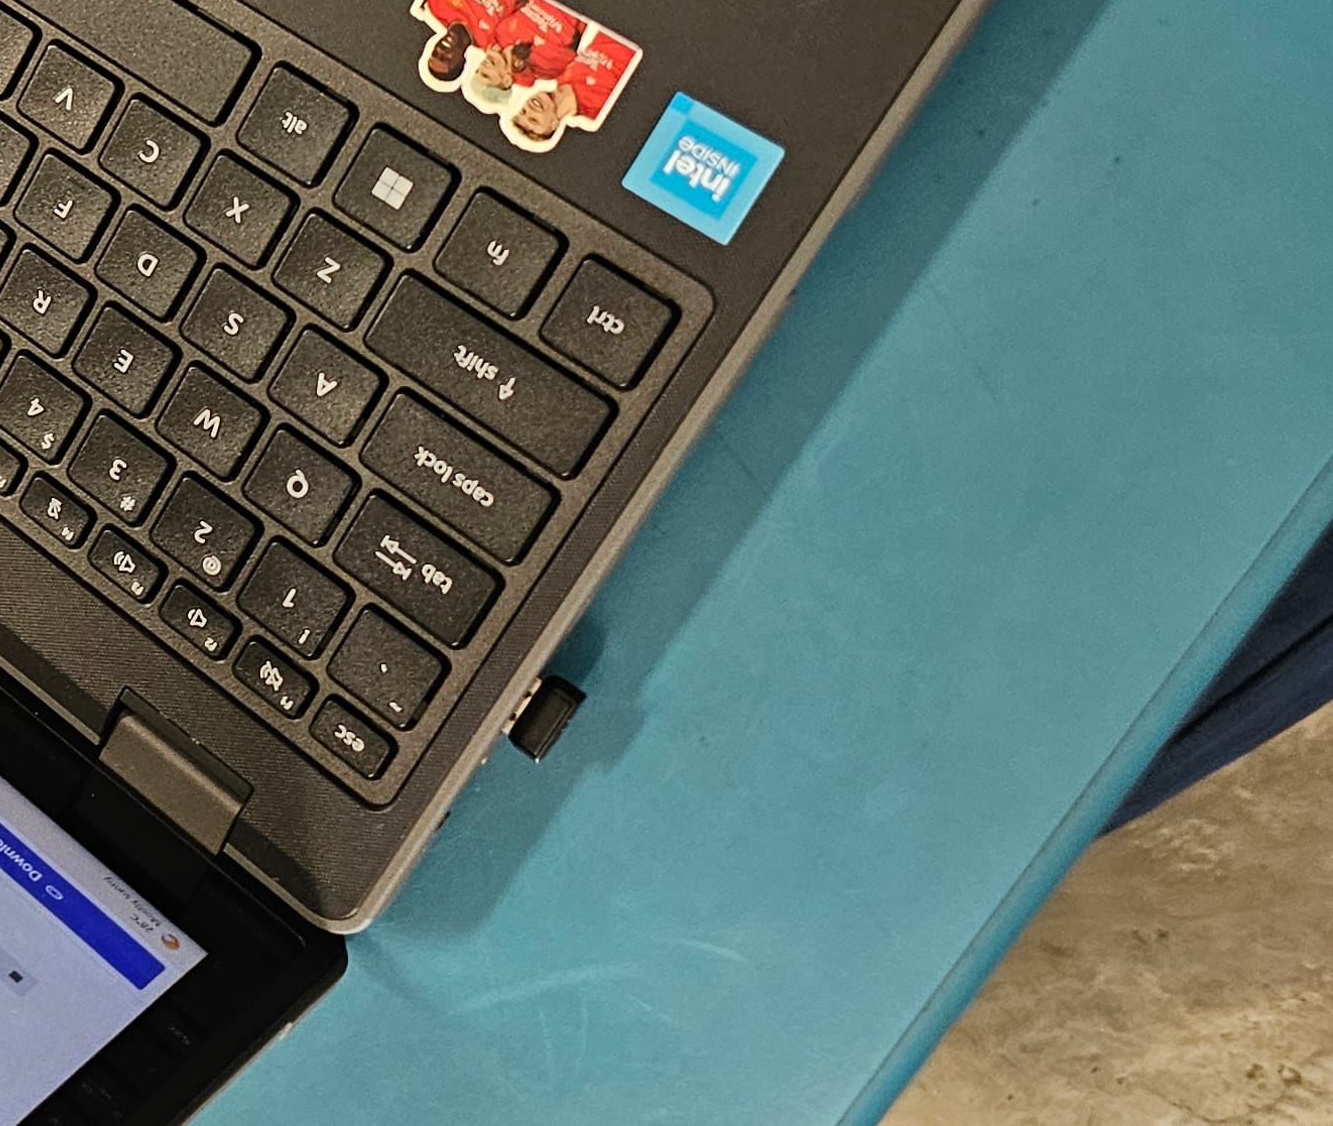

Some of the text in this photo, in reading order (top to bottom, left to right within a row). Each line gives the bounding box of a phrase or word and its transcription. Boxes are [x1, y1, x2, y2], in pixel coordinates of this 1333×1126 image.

[52, 85, 76, 110] V
[279, 111, 309, 136] alt
[137, 139, 161, 164] C
[676, 133, 741, 175] INSIDE
[661, 150, 731, 203] intel
[52, 198, 75, 220] F
[225, 195, 249, 223] X
[134, 250, 160, 278] D
[486, 240, 509, 265] fn
[315, 256, 342, 284] Z
[32, 288, 53, 316] R
[221, 309, 245, 335] S
[586, 305, 624, 334] ctrl
[112, 348, 133, 373] E
[453, 344, 498, 379] shift
[313, 371, 339, 396] A
[26, 397, 44, 416] 4
[193, 408, 222, 439] W
[108, 458, 127, 480] 3
[285, 468, 308, 498] Q
[414, 444, 494, 506] caps lock
[193, 519, 212, 543] 2
[418, 559, 456, 596] tab
[331, 721, 365, 751] esc
